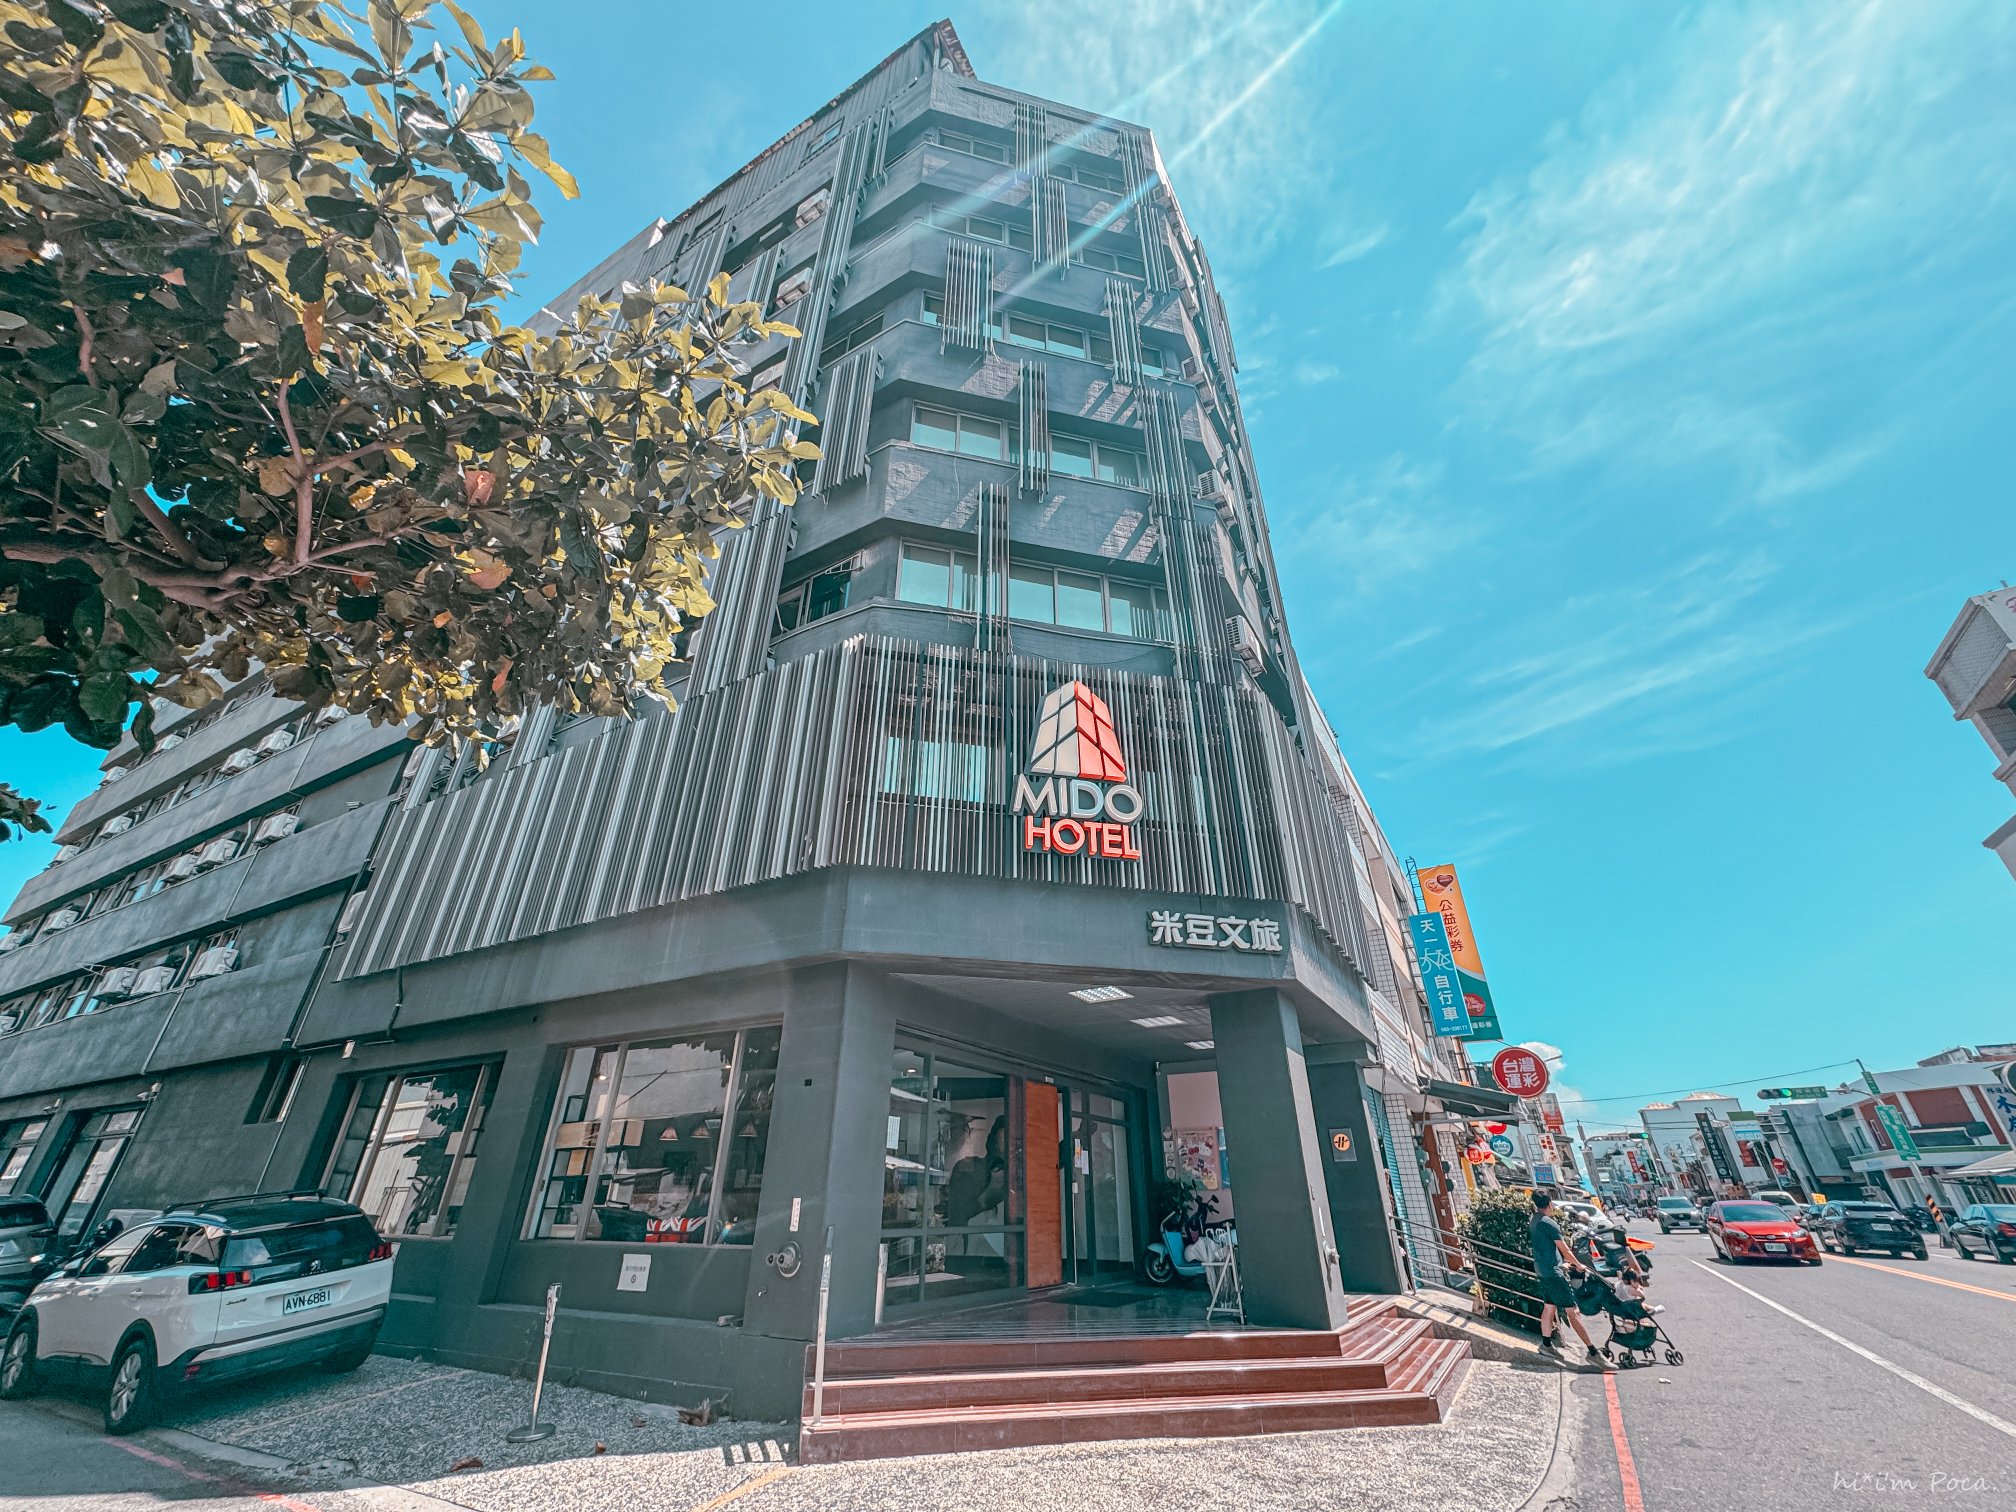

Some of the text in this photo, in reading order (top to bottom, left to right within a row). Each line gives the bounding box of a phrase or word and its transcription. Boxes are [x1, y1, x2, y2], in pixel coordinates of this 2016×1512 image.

[1013, 773, 1144, 823] MIDO
[1024, 815, 1141, 860] HOTEL
[1150, 910, 1283, 951] 米豆文旅
[1420, 918, 1460, 1022] 天一 自行車
[1502, 1056, 1536, 1074] 台灣
[1504, 1072, 1541, 1089] 運彩
[285, 1289, 331, 1311] AVN-6881
